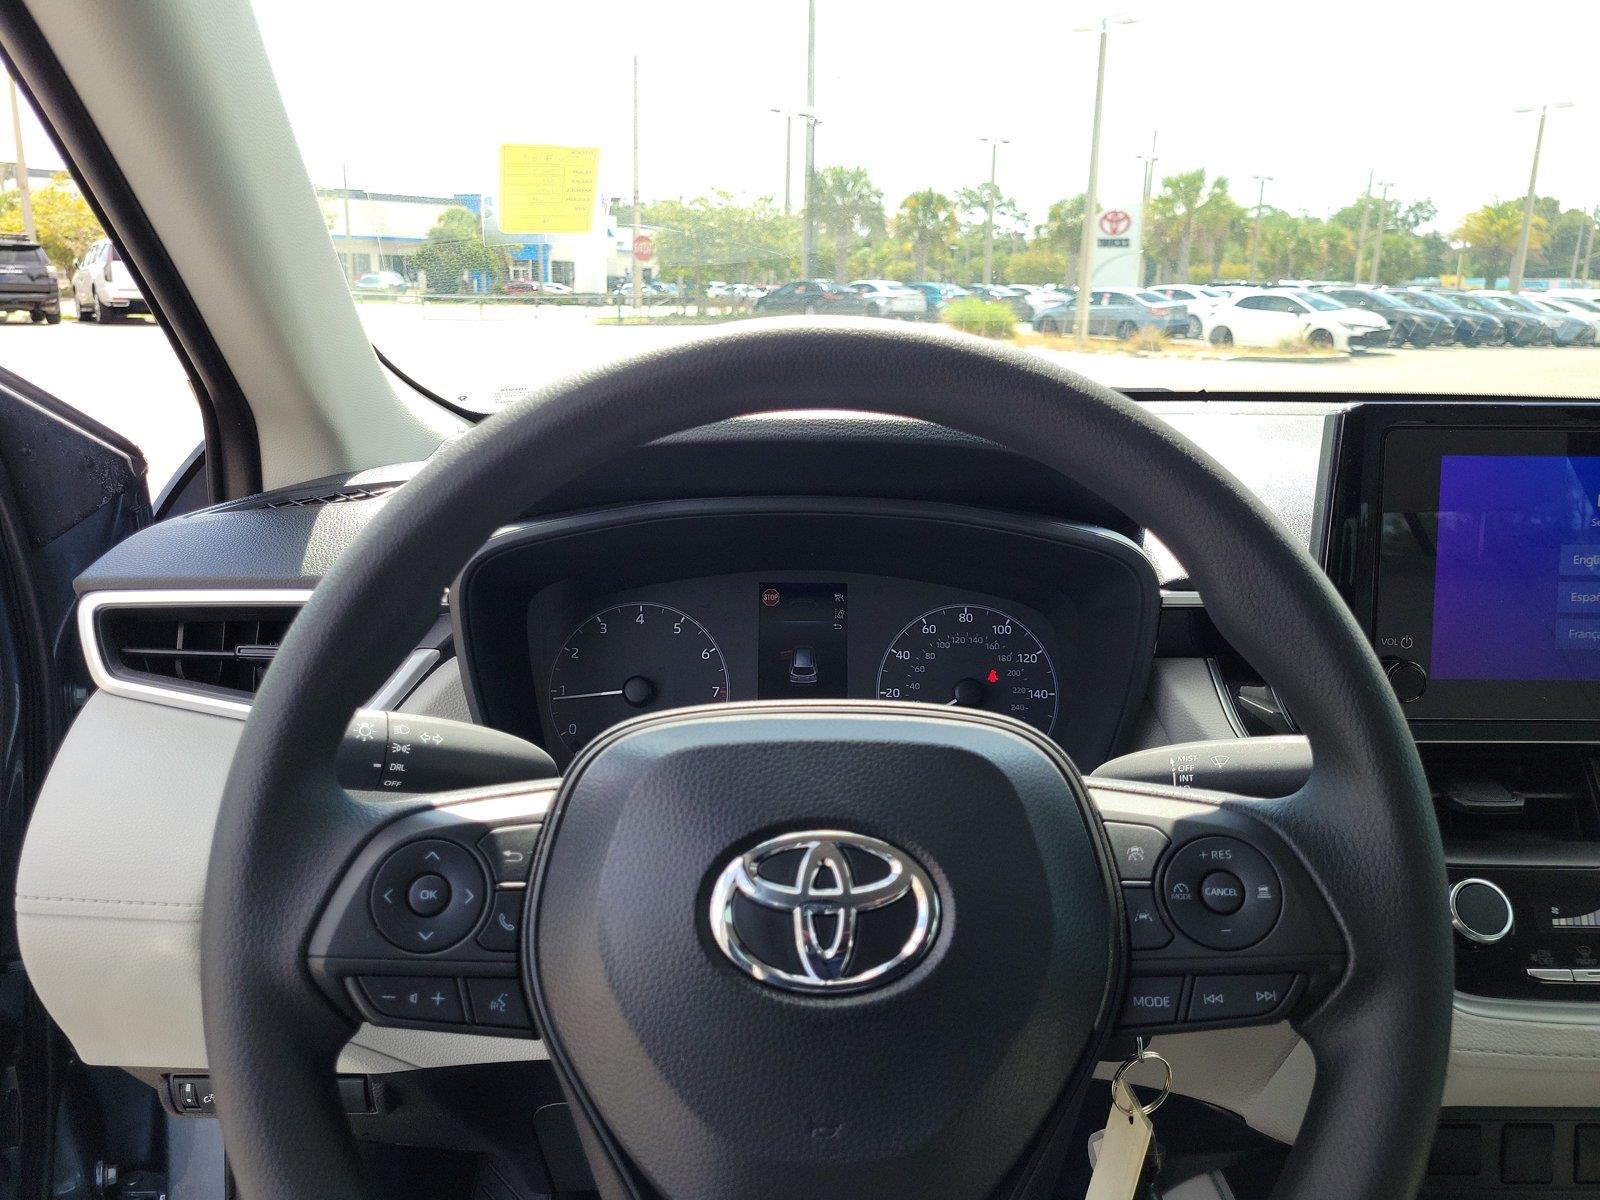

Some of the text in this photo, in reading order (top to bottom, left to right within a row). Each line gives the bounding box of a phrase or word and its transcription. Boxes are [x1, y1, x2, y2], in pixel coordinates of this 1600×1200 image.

[763, 593, 779, 601] STOP
[636, 613, 645, 625] 4
[959, 613, 973, 623] 80
[600, 623, 608, 634] 3
[673, 623, 681, 634] 5
[922, 625, 937, 634] 60
[992, 625, 1012, 635] 100
[951, 636, 966, 644] 120
[1381, 637, 1398, 646] VOL
[937, 641, 950, 649] 100
[985, 642, 1000, 650] 160
[571, 647, 579, 659] 2
[701, 649, 710, 660] 6
[895, 651, 910, 660] 40
[925, 652, 936, 660] 80
[998, 654, 1012, 662] 180
[1018, 653, 1038, 663] 120
[914, 665, 925, 673] 60
[1007, 669, 1021, 677] 200
[559, 685, 566, 696] 1
[909, 682, 921, 690] 40
[712, 686, 720, 698] 7
[886, 688, 900, 698] 20
[1028, 689, 1048, 699] 140
[1010, 704, 1025, 712] 240
[568, 724, 577, 735] 0
[1177, 754, 1197, 762] MIST
[389, 763, 405, 772] DRL
[1178, 764, 1194, 772] OFF
[1179, 774, 1194, 782] INT
[1211, 850, 1232, 860] RES
[420, 890, 438, 900] OK
[1204, 887, 1238, 896] CANCEL
[1133, 997, 1171, 1008] MODE
